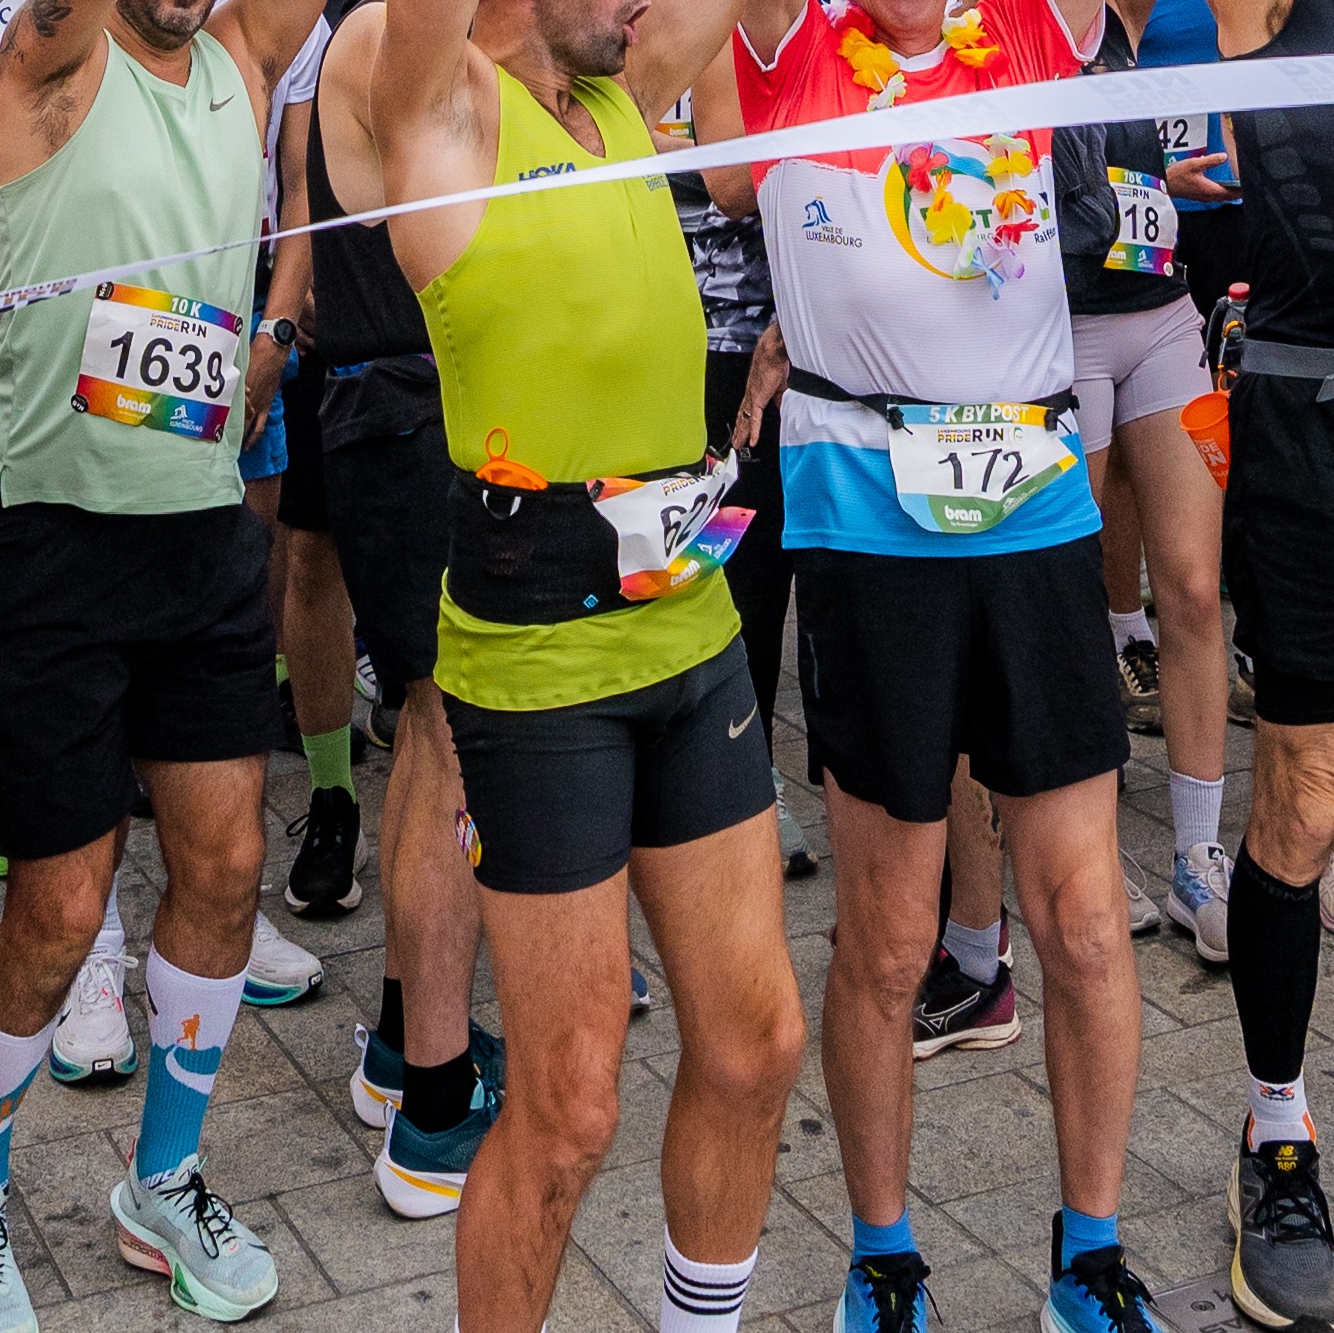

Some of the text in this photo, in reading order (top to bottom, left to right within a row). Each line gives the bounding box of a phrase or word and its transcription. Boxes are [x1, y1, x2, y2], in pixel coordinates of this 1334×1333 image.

[1124, 203, 1159, 242] 18
[805, 230, 863, 248] LUXEMBOURG
[171, 297, 203, 318] 10 K
[150, 318, 180, 332] PRIDE
[110, 331, 226, 399] 1639
[117, 394, 152, 415] bram
[929, 405, 1030, 423] 5 K BY POST
[937, 434, 971, 443] PRIDE
[938, 448, 1030, 494] 172
[662, 476, 700, 496] PRIDE
[944, 505, 983, 522] bram
